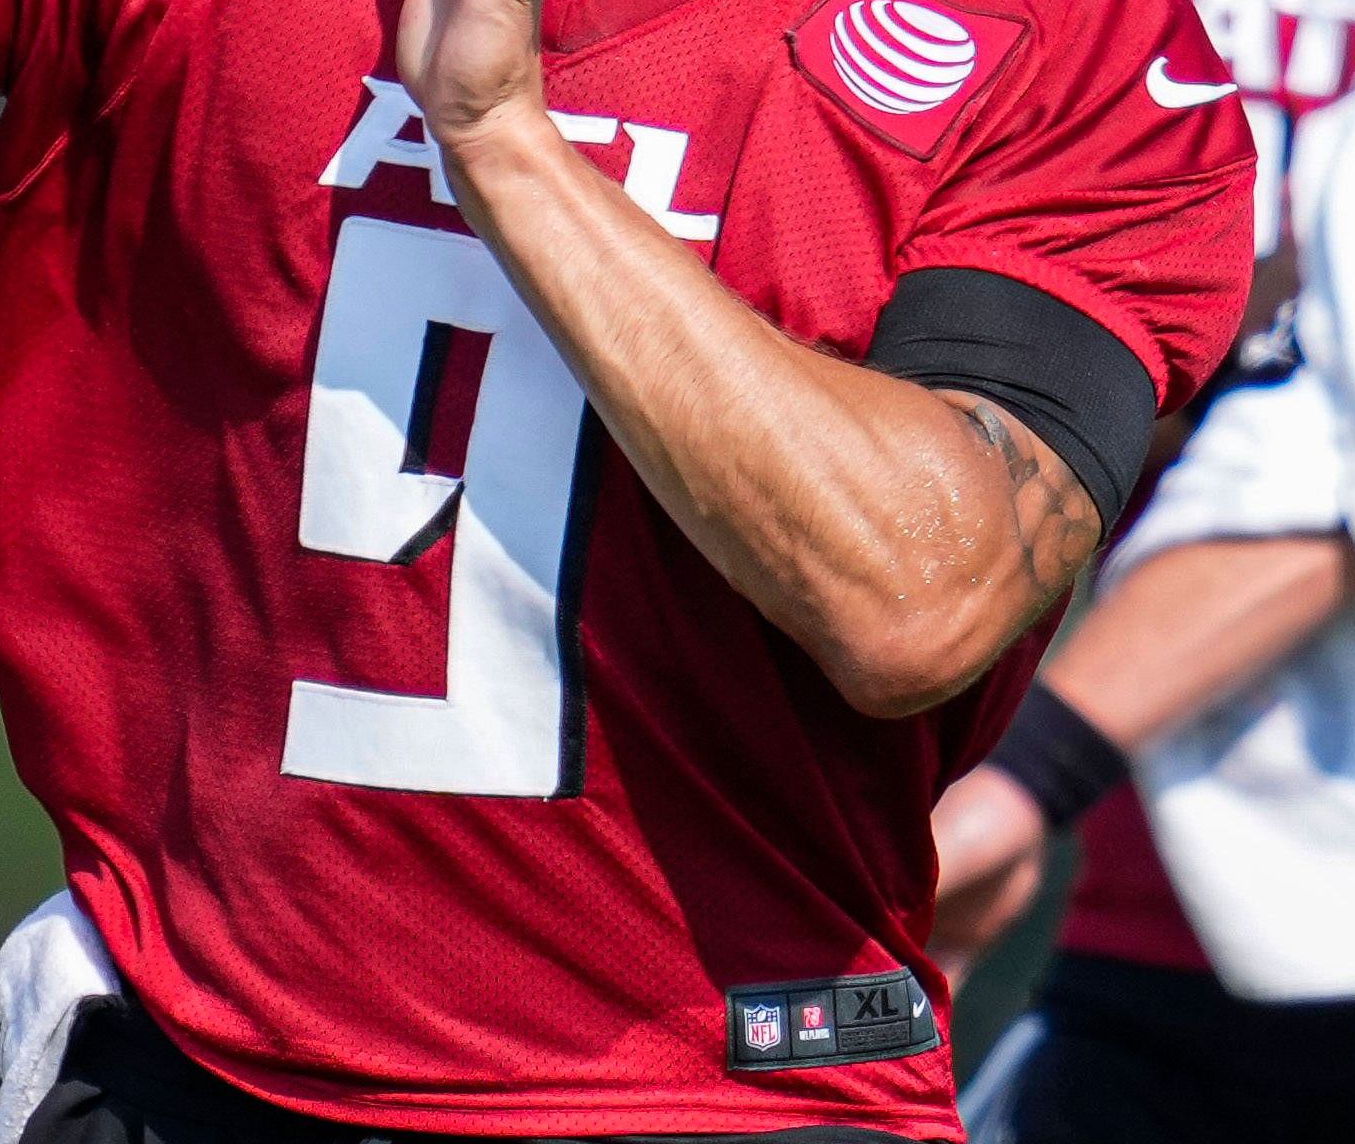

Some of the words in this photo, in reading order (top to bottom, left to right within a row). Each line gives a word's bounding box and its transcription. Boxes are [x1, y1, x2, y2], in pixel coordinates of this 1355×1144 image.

[317, 74, 720, 242] AL
[279, 215, 587, 800] 9
[750, 1022, 776, 1044] NFL
[853, 987, 900, 1021] XL
